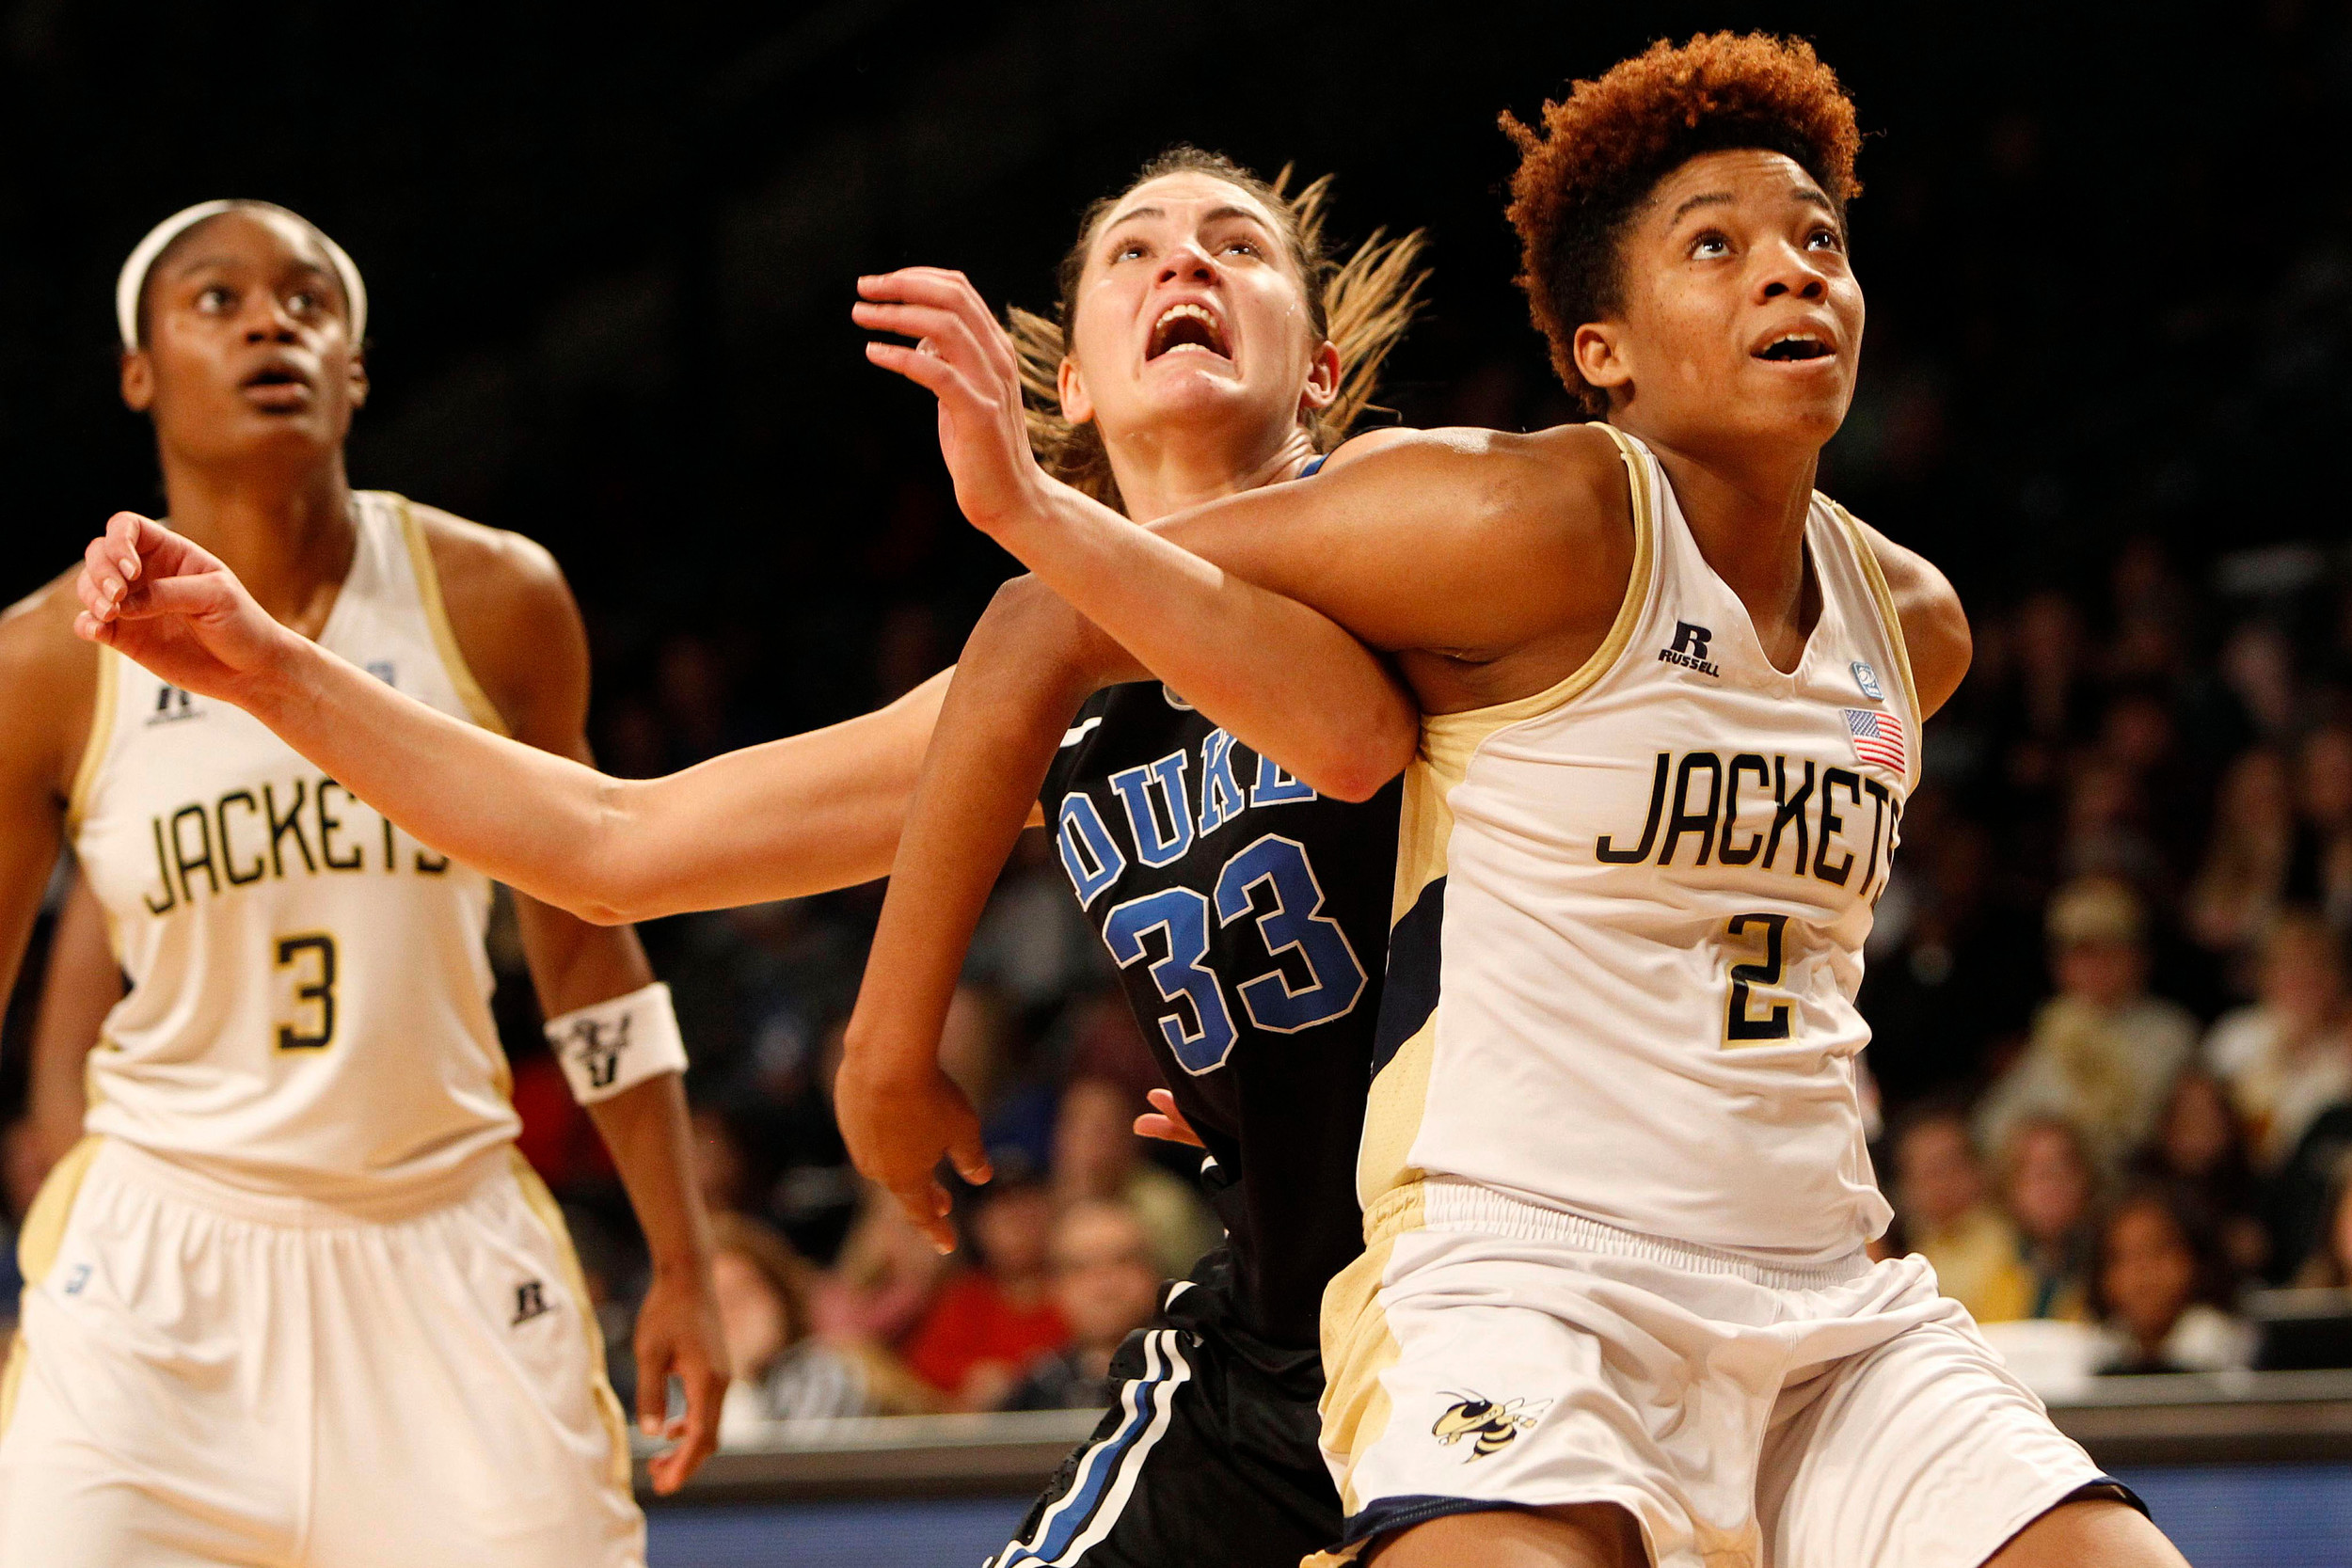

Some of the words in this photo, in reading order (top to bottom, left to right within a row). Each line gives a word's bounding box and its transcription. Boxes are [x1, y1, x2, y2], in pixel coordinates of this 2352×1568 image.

[1658, 648, 1720, 678] RUSSELL
[1670, 620, 1712, 659] R
[275, 933, 337, 1053] 3
[1103, 832, 1369, 1076] 33
[1721, 912, 1795, 1050] 2
